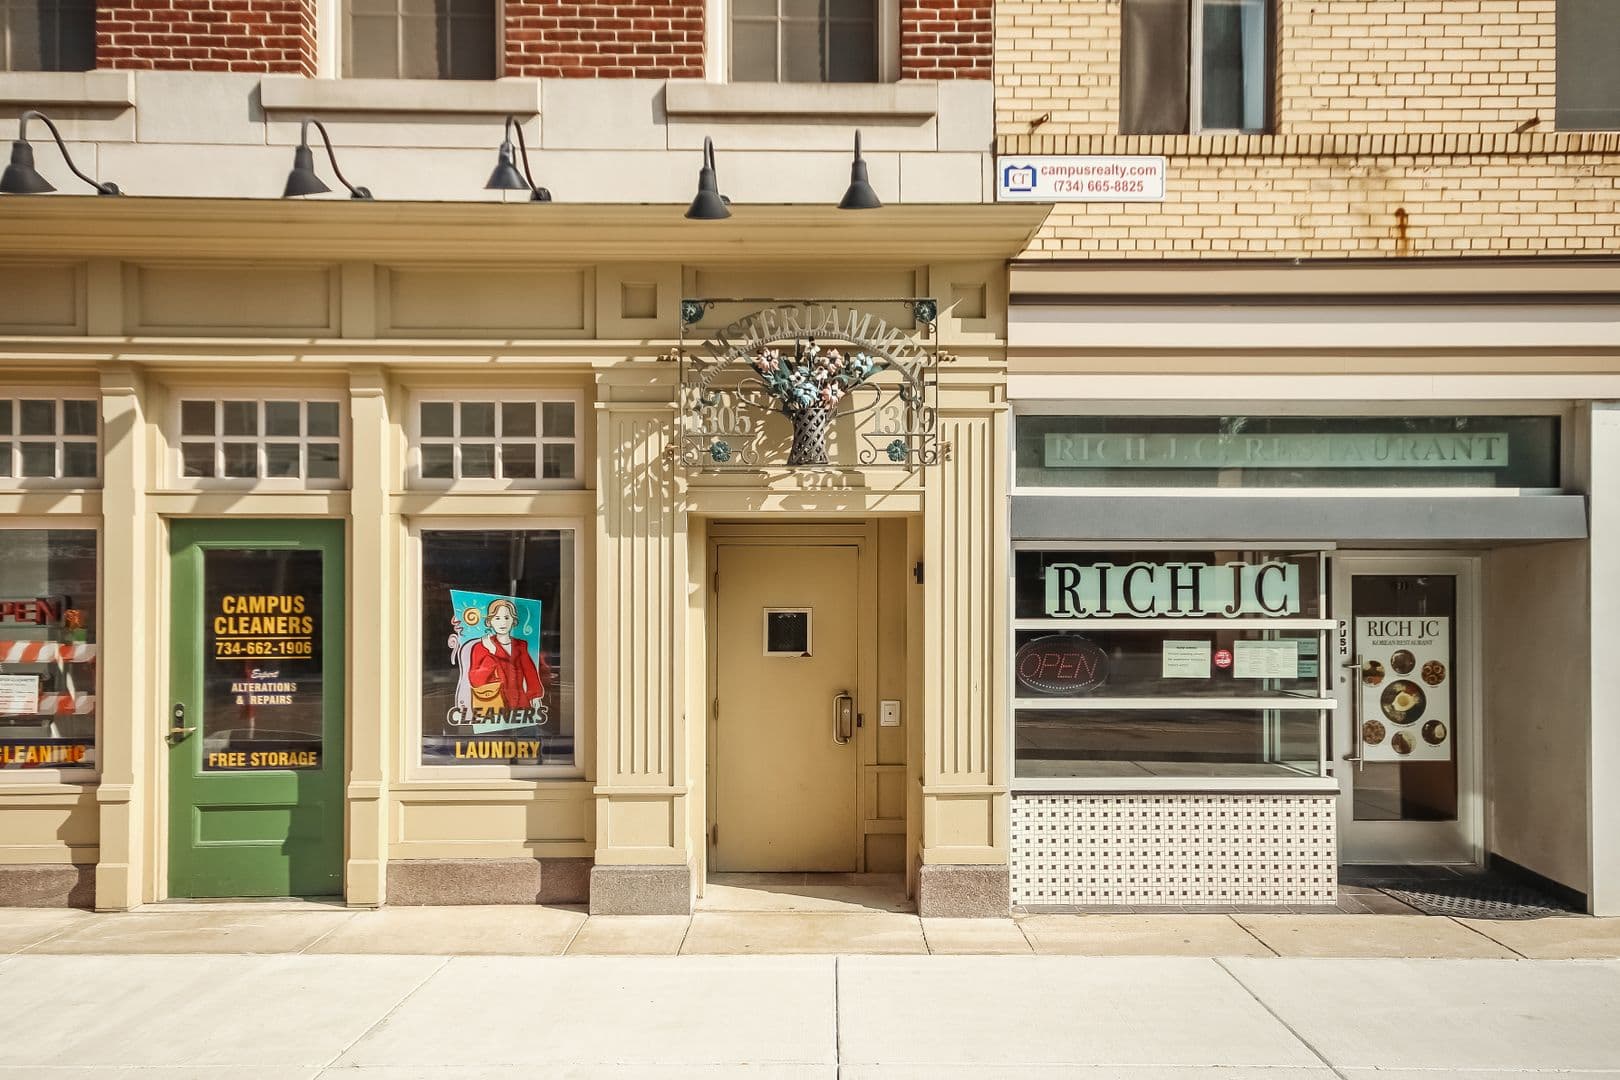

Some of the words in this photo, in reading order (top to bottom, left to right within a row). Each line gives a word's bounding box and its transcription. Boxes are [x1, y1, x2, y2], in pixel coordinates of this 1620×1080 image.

[1041, 164, 1157, 181] campusrealty.com
[1053, 180, 1084, 193] (734)
[1087, 180, 1144, 193] 665-8825
[870, 405, 935, 433] 1309
[1053, 563, 1206, 615] RICH
[1224, 563, 1289, 614] JC
[0, 600, 57, 625] PEN
[222, 595, 305, 614] CAMPUS
[214, 616, 313, 634] CLEANERS
[1368, 620, 1412, 637] RICH
[1418, 620, 1440, 639] JC
[1339, 620, 1348, 655] PUSH
[216, 641, 312, 655] 734-662-1906
[1020, 653, 1099, 679] OPEN
[231, 682, 297, 693] ALTERATIONS
[236, 695, 244, 705] &
[250, 695, 293, 705] REPAIRS
[447, 706, 549, 726] CLEANERS
[0, 745, 86, 763] LEANING
[208, 752, 246, 767] FREE
[250, 751, 317, 766] STORAGE
[455, 741, 541, 759] LAUNDRY
